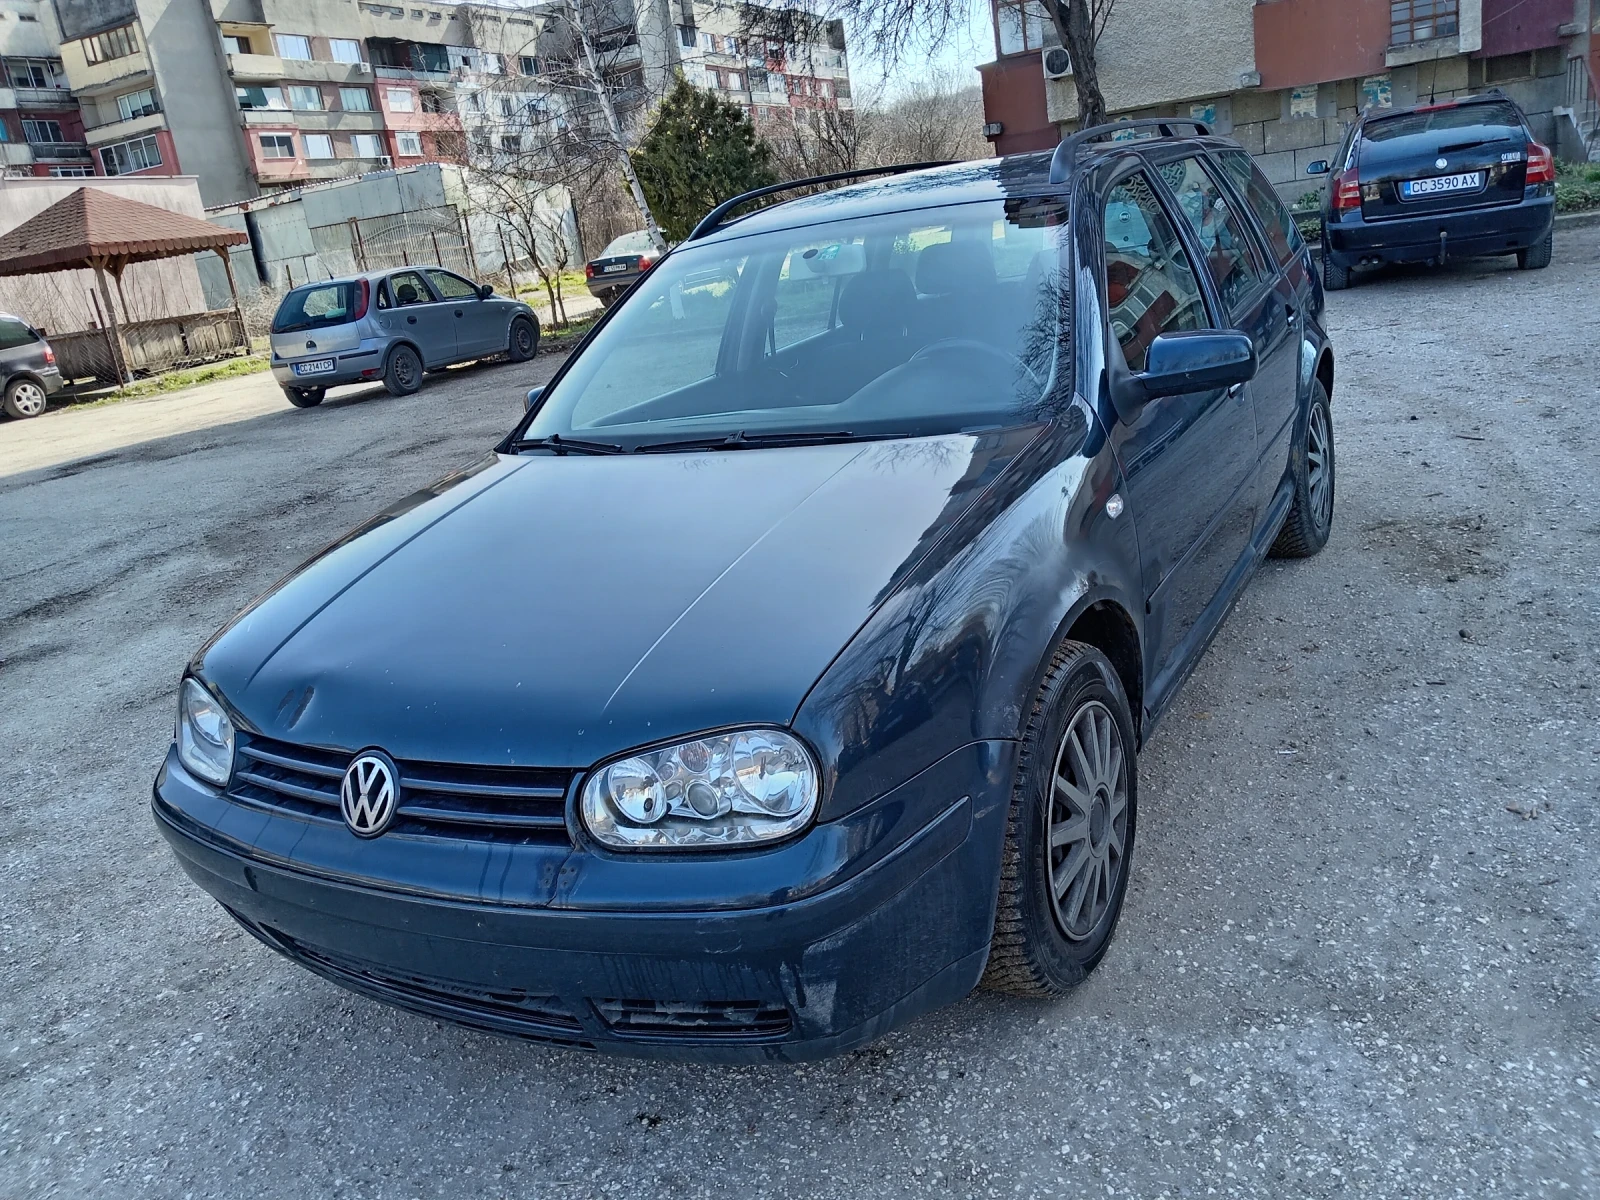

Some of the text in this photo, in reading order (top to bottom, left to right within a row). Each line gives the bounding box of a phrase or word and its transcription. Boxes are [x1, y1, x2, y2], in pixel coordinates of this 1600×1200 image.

[1412, 174, 1476, 193] CC 3590 AX
